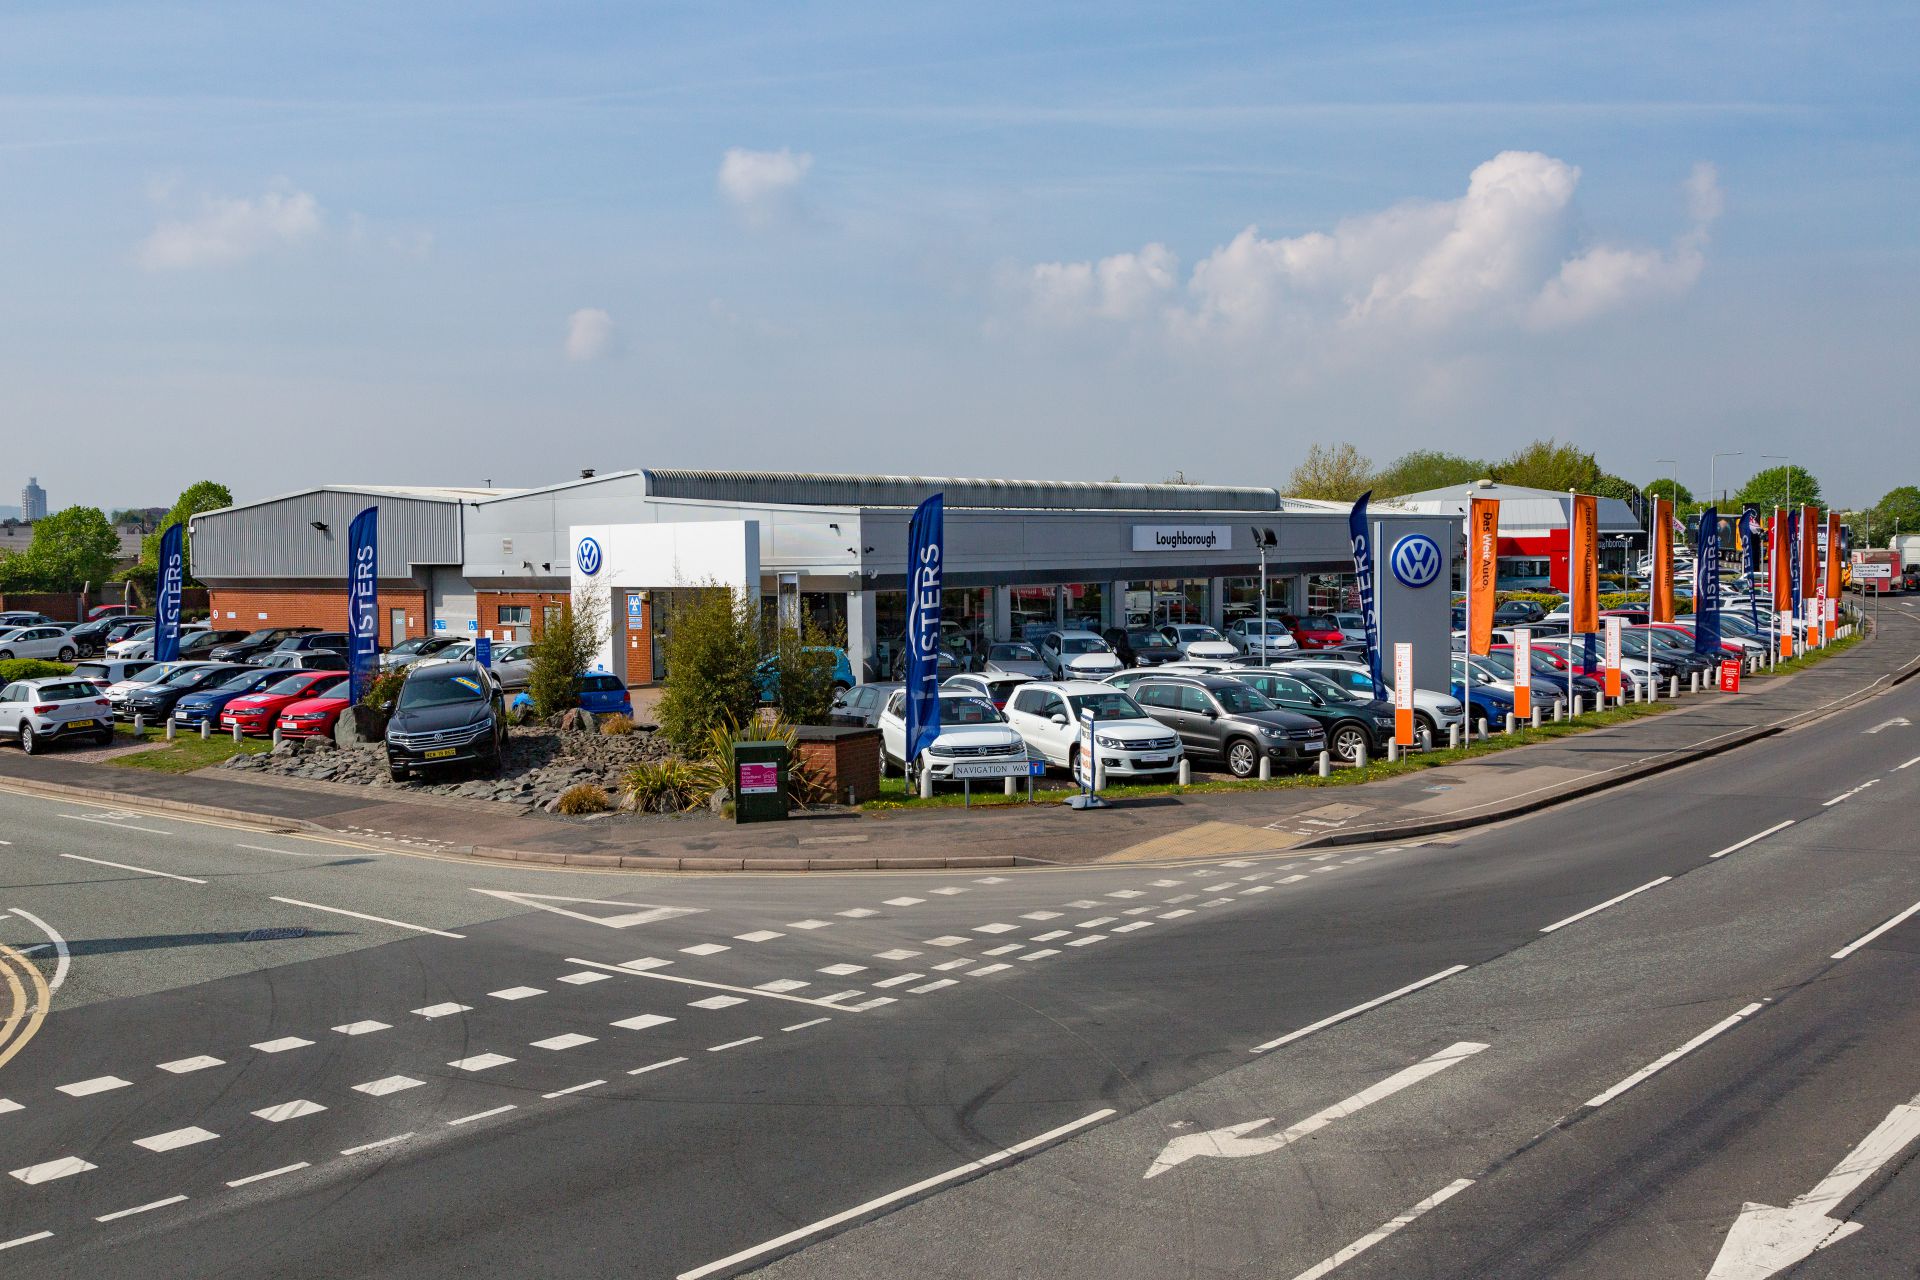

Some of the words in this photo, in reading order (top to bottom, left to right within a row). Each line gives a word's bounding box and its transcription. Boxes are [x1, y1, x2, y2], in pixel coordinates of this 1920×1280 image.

[1156, 530, 1216, 548] Loughborough
[1483, 512, 1493, 532] Das
[166, 553, 181, 639] LISTERS
[1706, 534, 1717, 612] LISTERS
[357, 545, 375, 655] LISTERS
[956, 766, 1007, 774] NAVIGATION
